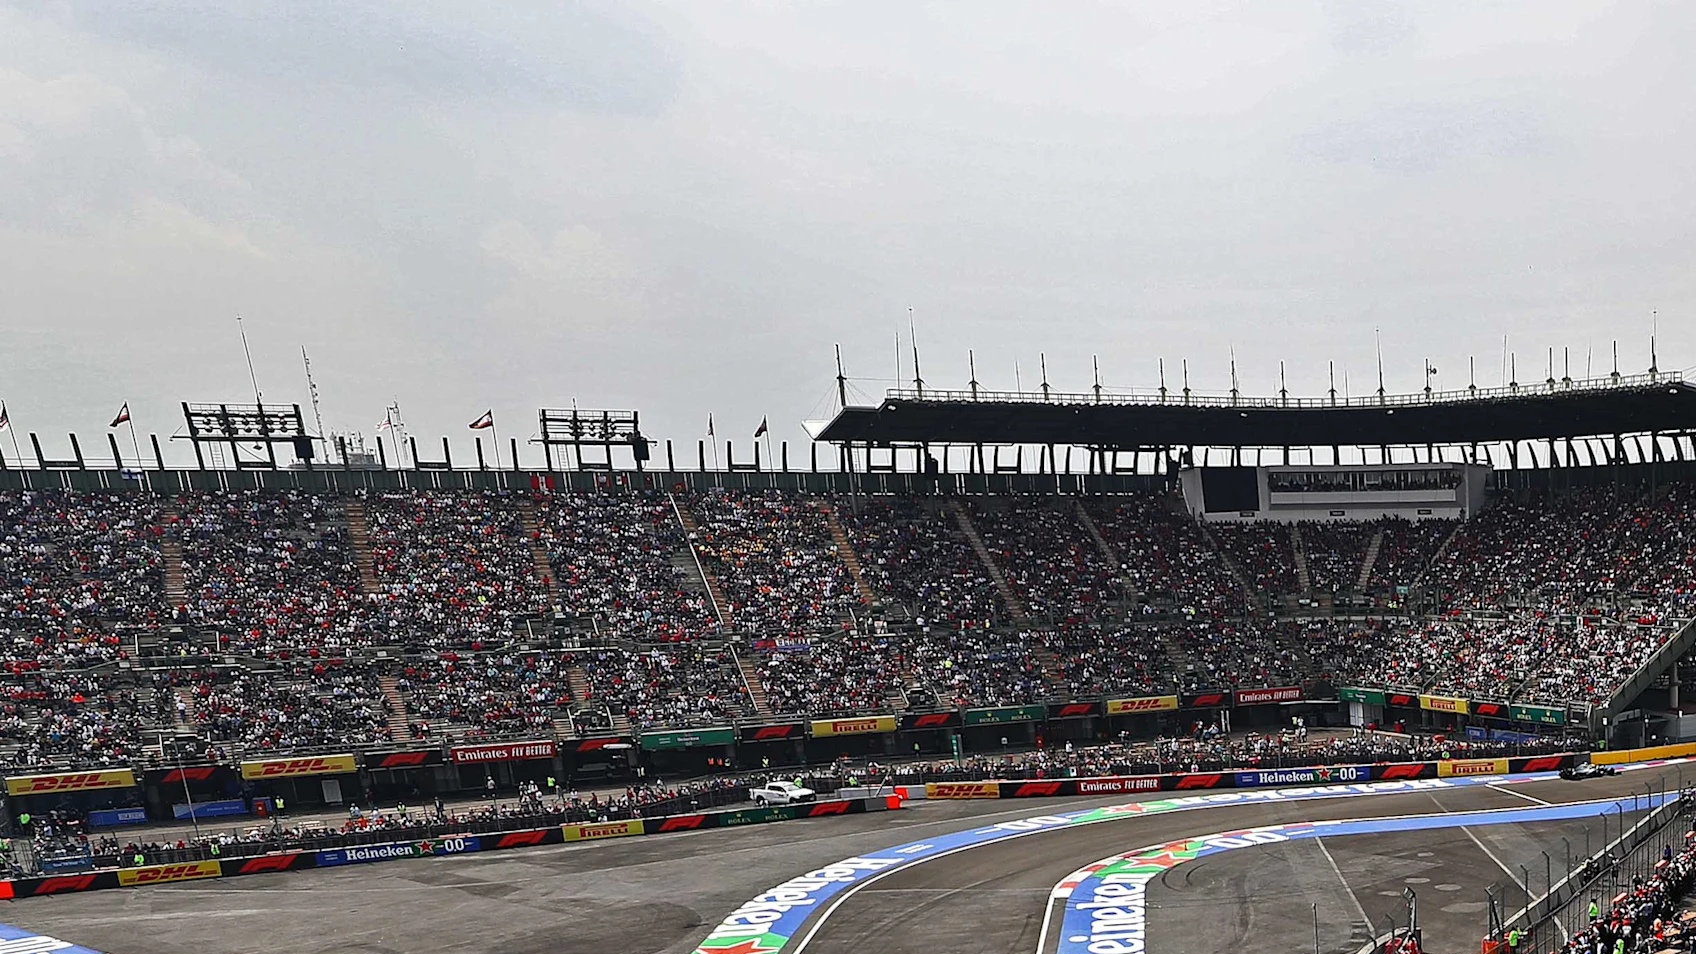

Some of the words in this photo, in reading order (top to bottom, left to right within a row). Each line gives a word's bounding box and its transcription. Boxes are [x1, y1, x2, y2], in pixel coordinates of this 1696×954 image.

[1239, 692, 1272, 702] Emirates
[1120, 699, 1162, 710] DHL
[1430, 699, 1456, 711] PIRELLI
[832, 719, 878, 733] PIRELLI
[457, 749, 508, 763] Emirates
[511, 746, 529, 757] FLY
[530, 744, 552, 756] BETTER
[262, 758, 330, 775] DHL
[1452, 762, 1494, 774] PIRELLI
[31, 773, 107, 791] DHL
[1259, 772, 1314, 785] Heineken
[936, 784, 987, 797] DHL
[1080, 781, 1122, 792] Emirates
[1124, 780, 1134, 790] FLY
[1136, 779, 1158, 789] BETTER
[580, 823, 629, 838] PIRELLI
[346, 845, 414, 862] Heineken
[134, 864, 205, 883] DHL
